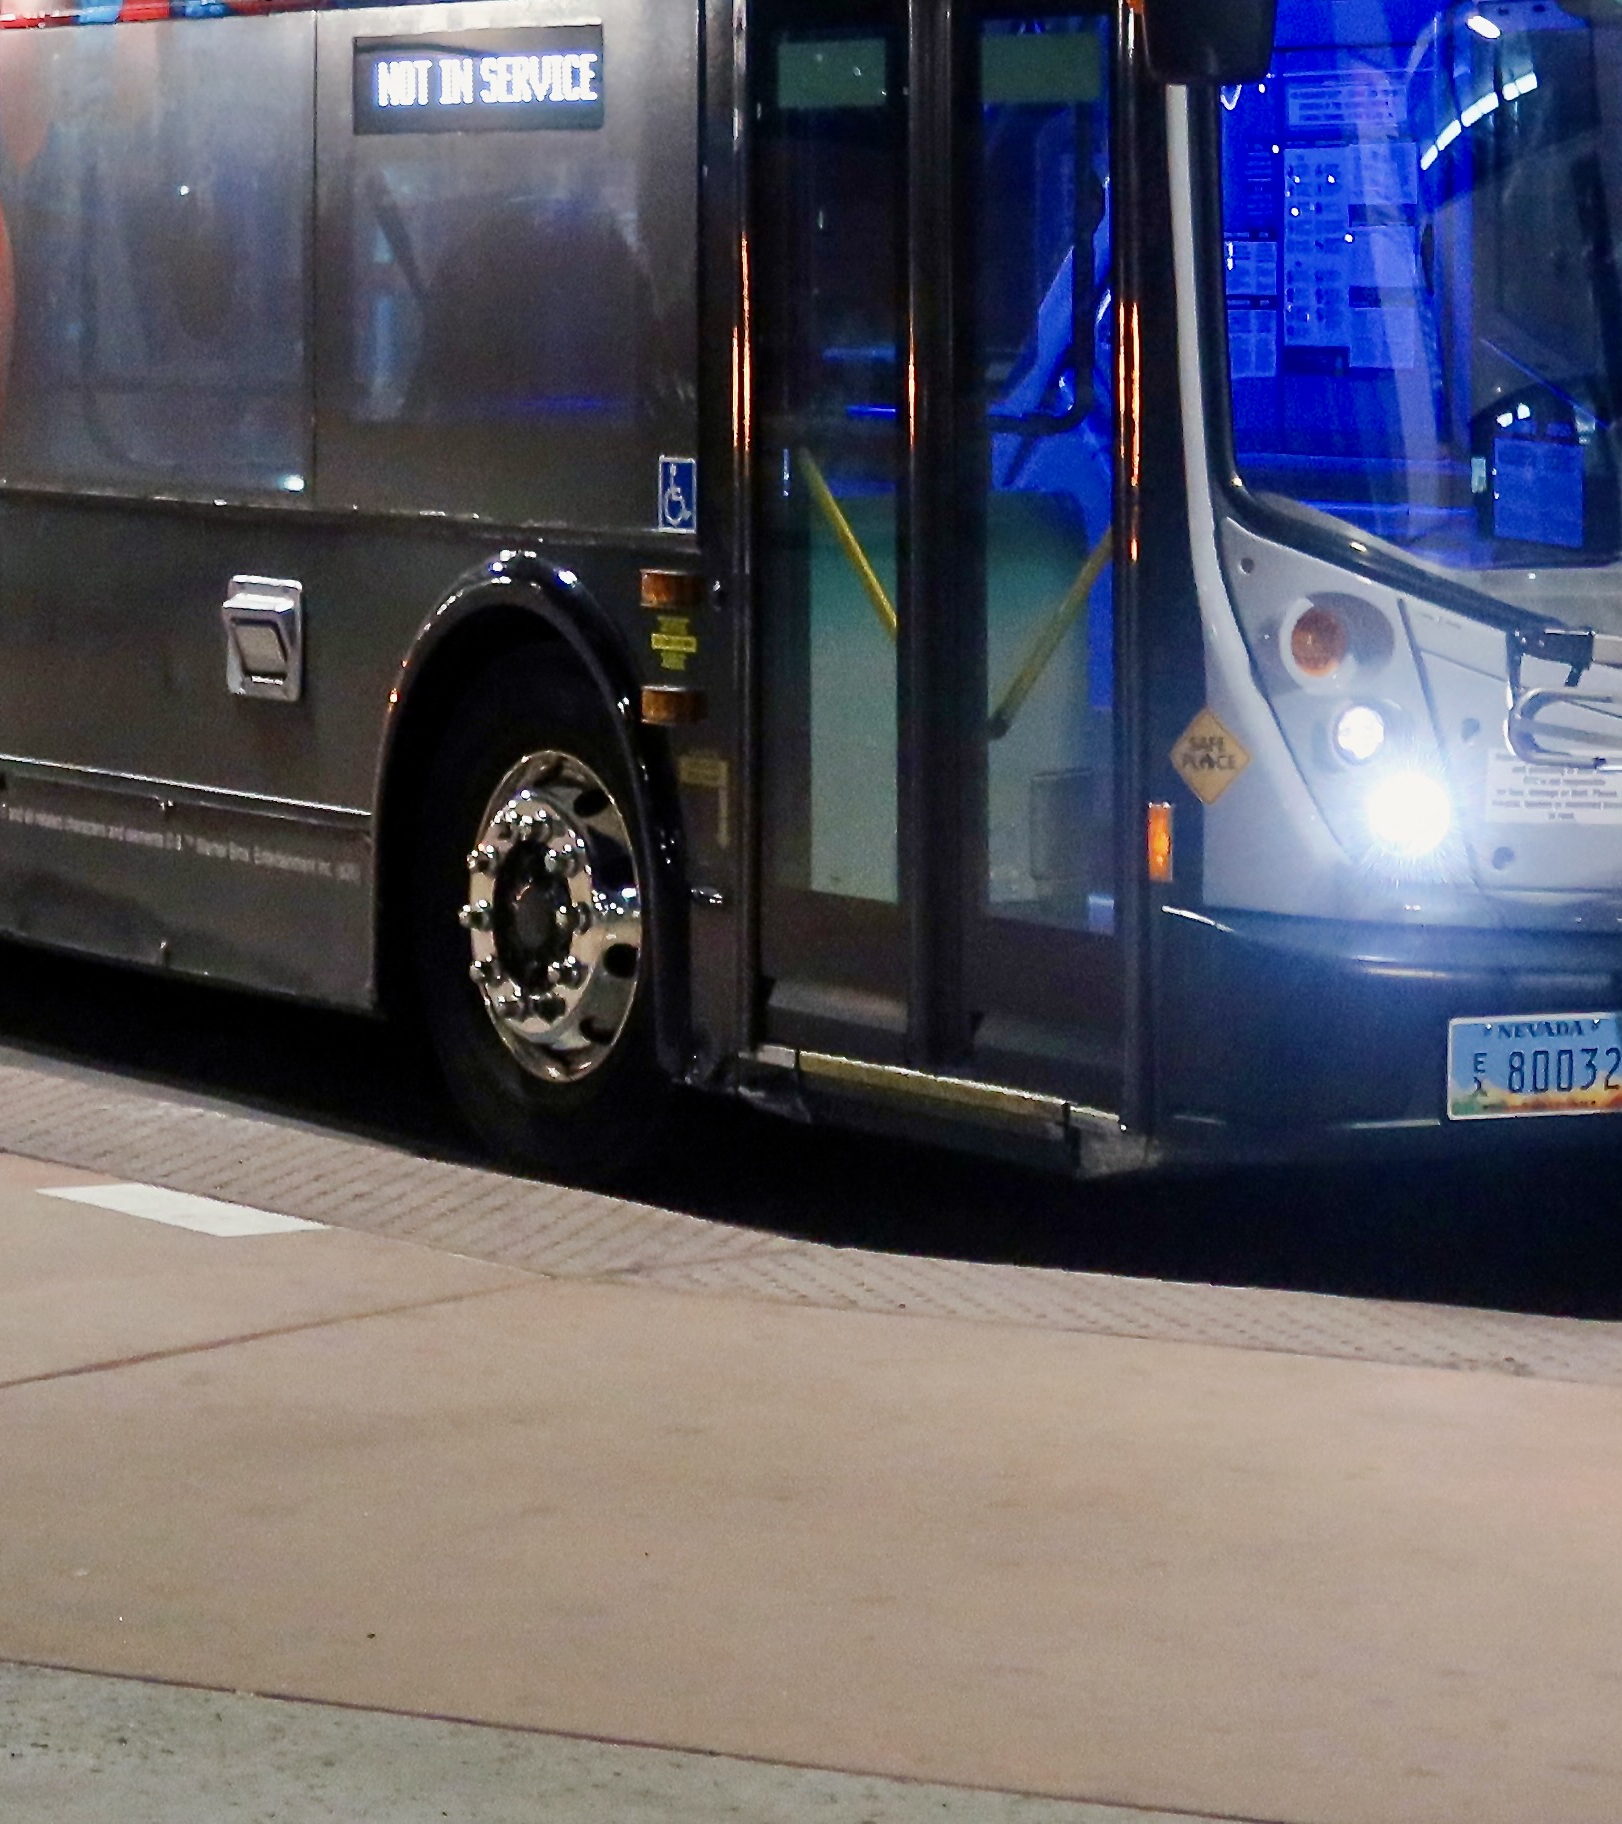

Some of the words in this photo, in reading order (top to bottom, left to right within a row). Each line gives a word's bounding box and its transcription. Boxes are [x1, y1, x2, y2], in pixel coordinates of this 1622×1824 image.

[378, 60, 433, 107] NOT
[439, 58, 474, 105] IN
[480, 54, 598, 104] SERVICE
[1497, 1019, 1585, 1039] NEVADA
[1508, 1047, 1622, 1093] 80032
